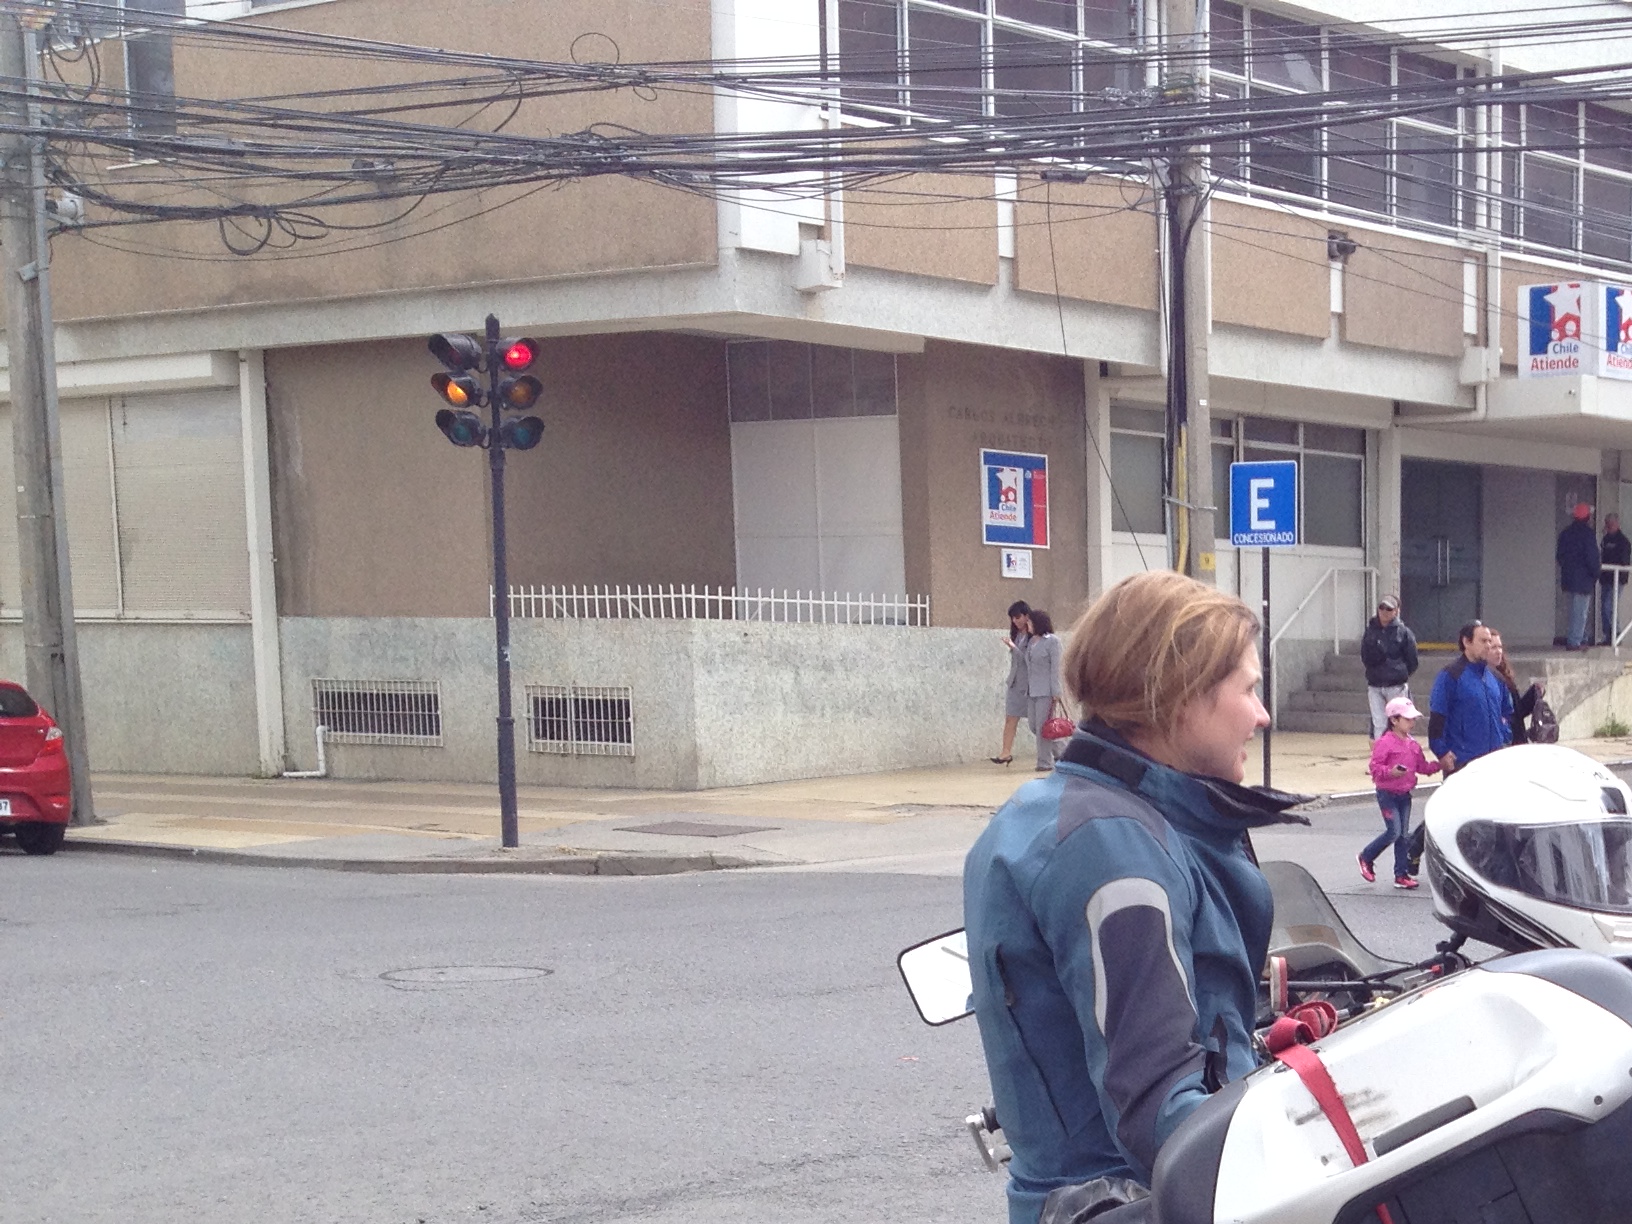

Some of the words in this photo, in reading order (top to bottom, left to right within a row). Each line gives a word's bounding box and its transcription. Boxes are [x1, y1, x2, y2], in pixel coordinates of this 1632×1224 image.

[1552, 343, 1579, 355] Chile
[1530, 355, 1579, 371] Atiende
[1250, 478, 1276, 530] E
[1234, 531, 1294, 544] CONCESIONADO
